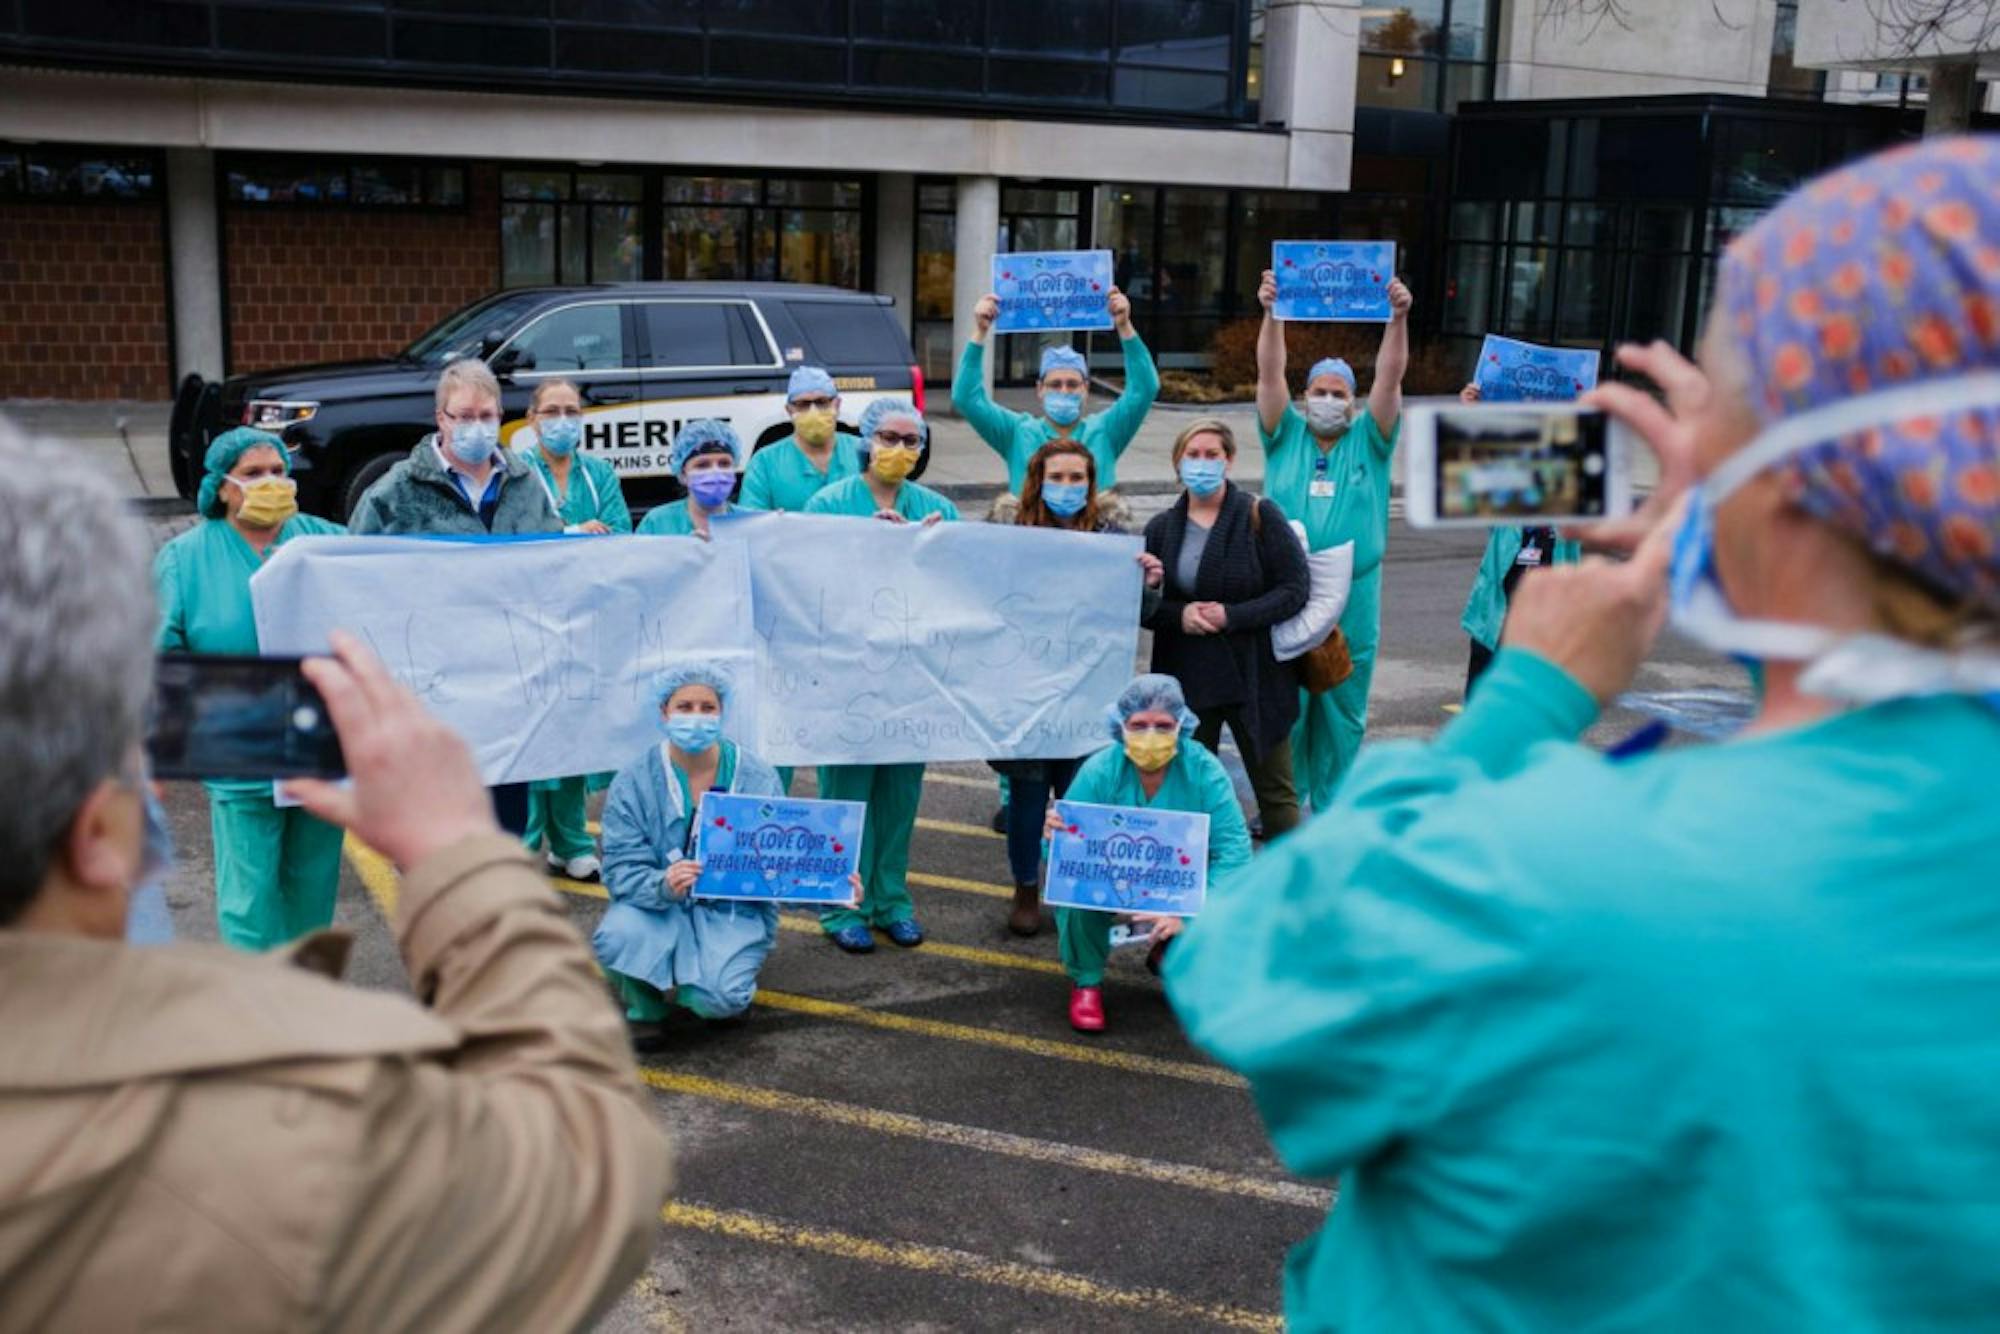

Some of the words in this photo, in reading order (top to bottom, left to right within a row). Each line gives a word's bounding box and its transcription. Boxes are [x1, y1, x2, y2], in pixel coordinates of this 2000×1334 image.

[1019, 279, 1034, 293] WE
[1037, 278, 1062, 293] LOVE
[1063, 277, 1087, 293] OUR
[1317, 267, 1342, 282] LOVE
[1345, 268, 1367, 281] OUR
[1519, 369, 1544, 384] LOVE
[577, 417, 731, 450] HERI
[976, 591, 1098, 671] Safe
[736, 829, 756, 848] WE
[760, 831, 795, 850] LOVE
[796, 834, 827, 851] OUR
[1086, 838, 1107, 857] WE
[1110, 841, 1145, 861] LOVE
[1145, 843, 1174, 864] OUR
[706, 852, 792, 874] HEALTHCARE
[795, 855, 849, 875] HEROES
[1058, 859, 1142, 883] HEALTHCARE
[1146, 868, 1197, 889] HEROES
